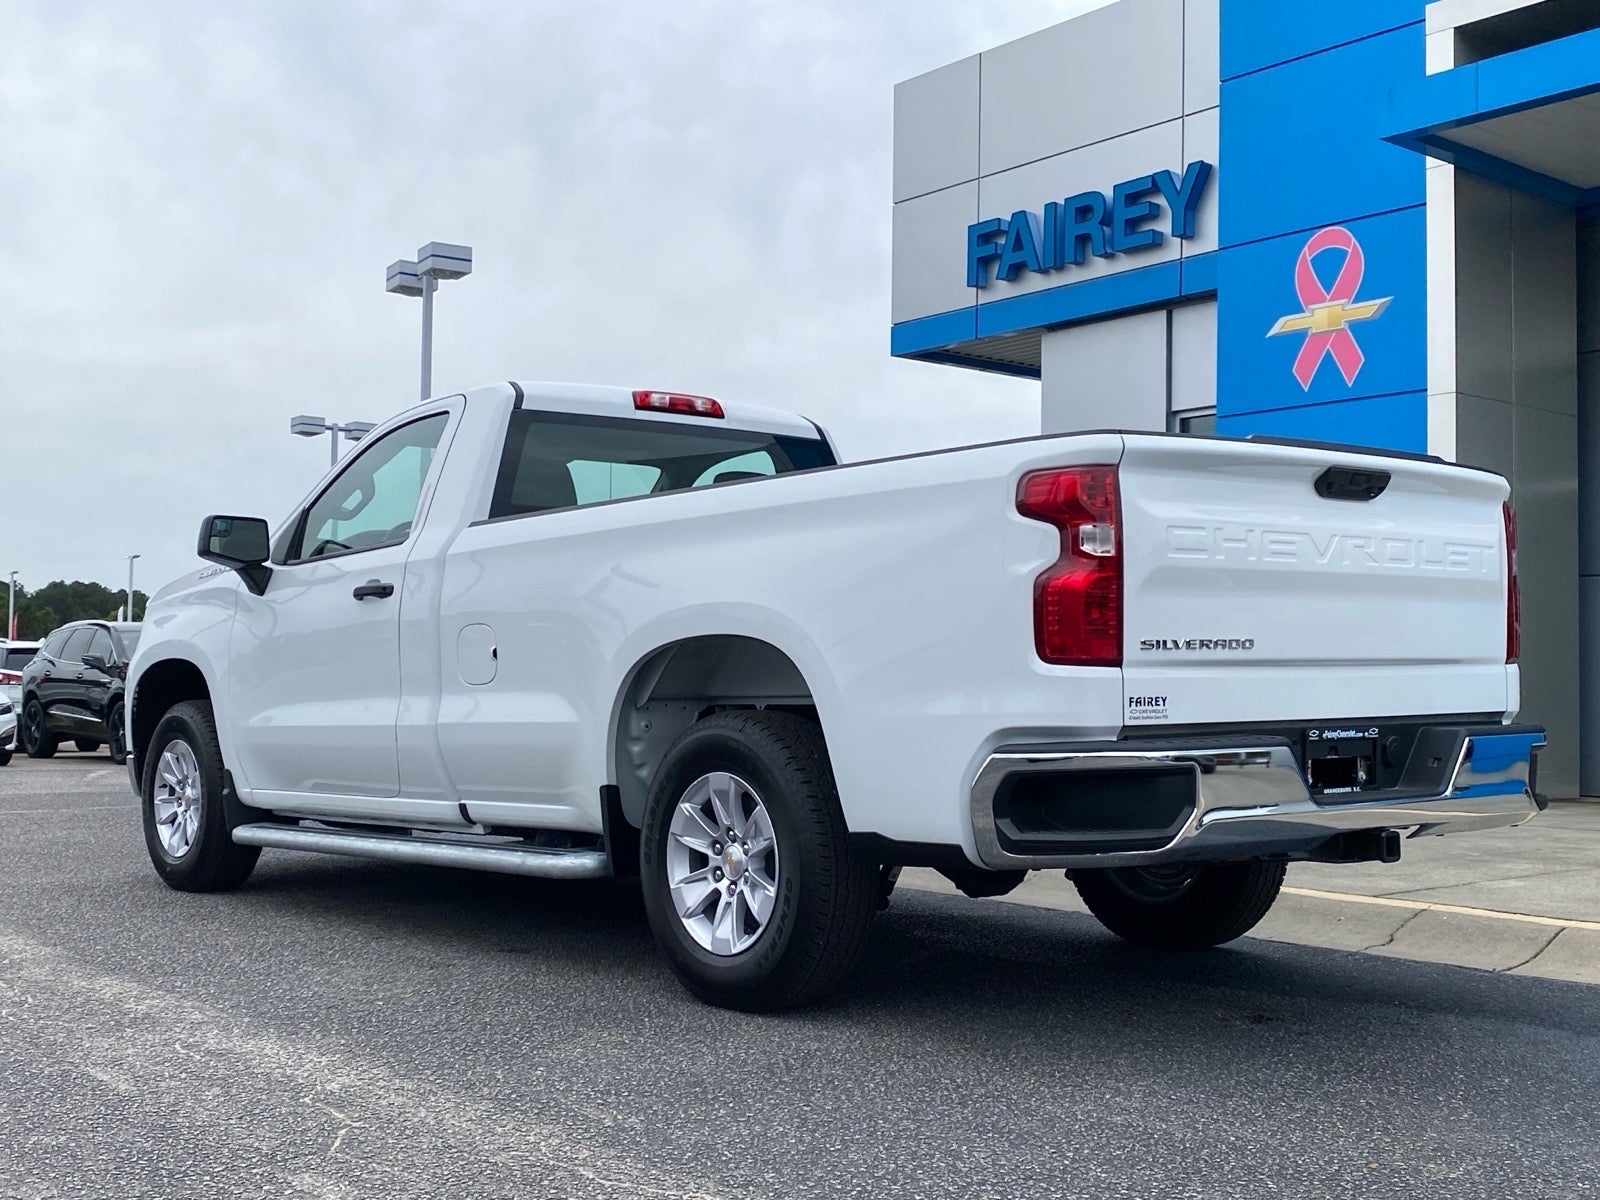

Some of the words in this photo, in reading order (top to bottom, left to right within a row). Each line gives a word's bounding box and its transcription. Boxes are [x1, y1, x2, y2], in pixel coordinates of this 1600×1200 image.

[966, 160, 1212, 289] FAIREY
[1166, 524, 1496, 573] CHEVROLET
[1139, 638, 1255, 651] SILVERADO
[1128, 696, 1168, 708] FAIREY
